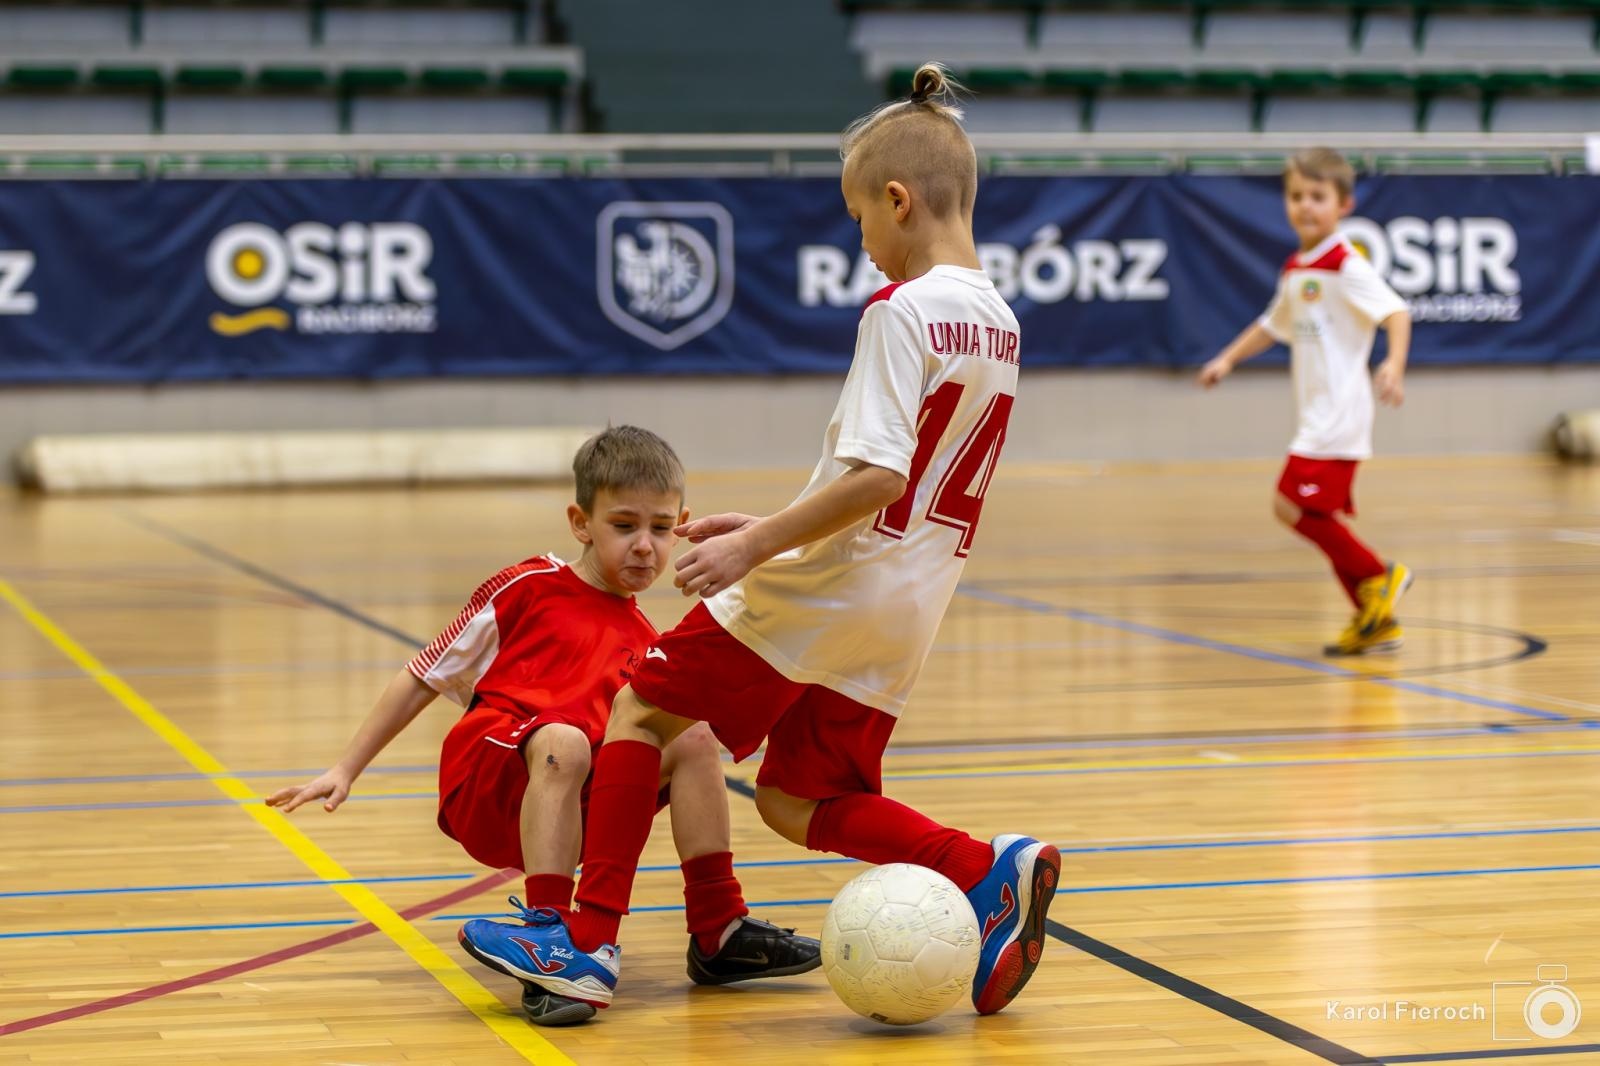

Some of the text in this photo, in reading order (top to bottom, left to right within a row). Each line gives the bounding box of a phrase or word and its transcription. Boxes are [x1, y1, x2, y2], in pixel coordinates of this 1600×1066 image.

[206, 221, 437, 305] OSiR
[928, 322, 1020, 366] UNIA TUR
[872, 380, 1015, 558] 14
